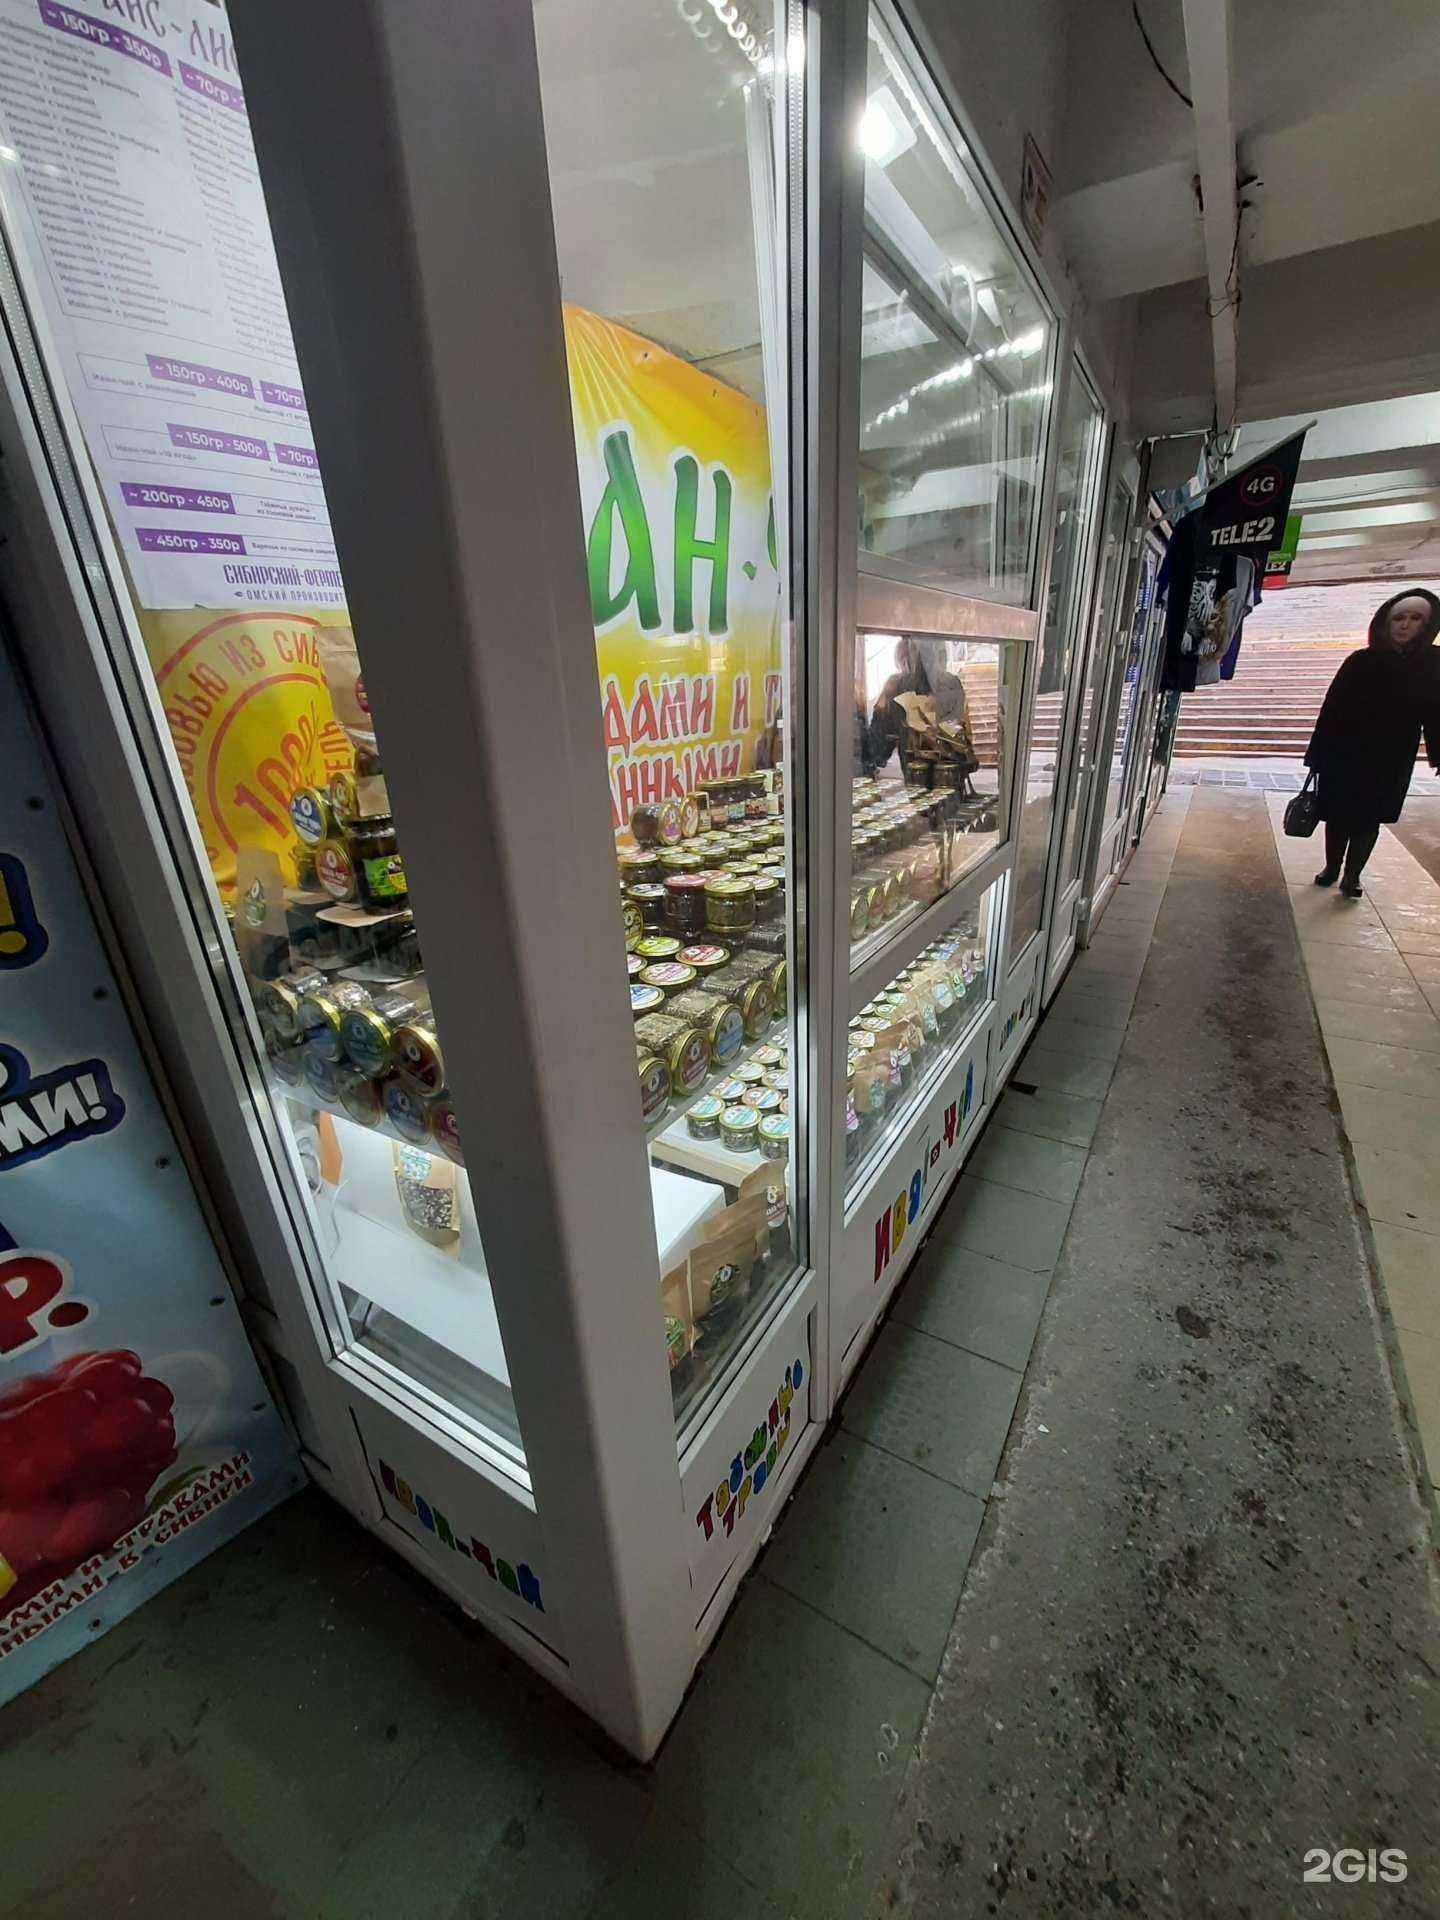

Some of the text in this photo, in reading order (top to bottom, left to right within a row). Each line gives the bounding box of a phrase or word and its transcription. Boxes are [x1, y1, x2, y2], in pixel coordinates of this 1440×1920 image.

[60, 12, 111, 45] 150гр
[166, 363, 206, 385] 150гр
[216, 376, 249, 395] 400р
[185, 431, 224, 451] 150гр
[233, 439, 264, 457] 500р
[1247, 475, 1275, 494] 4G
[141, 489, 186, 508] 200гр
[197, 493, 230, 511] 450р
[156, 535, 200, 552] 450гр
[208, 536, 240, 552] 350р
[1210, 517, 1275, 546] TELE2
